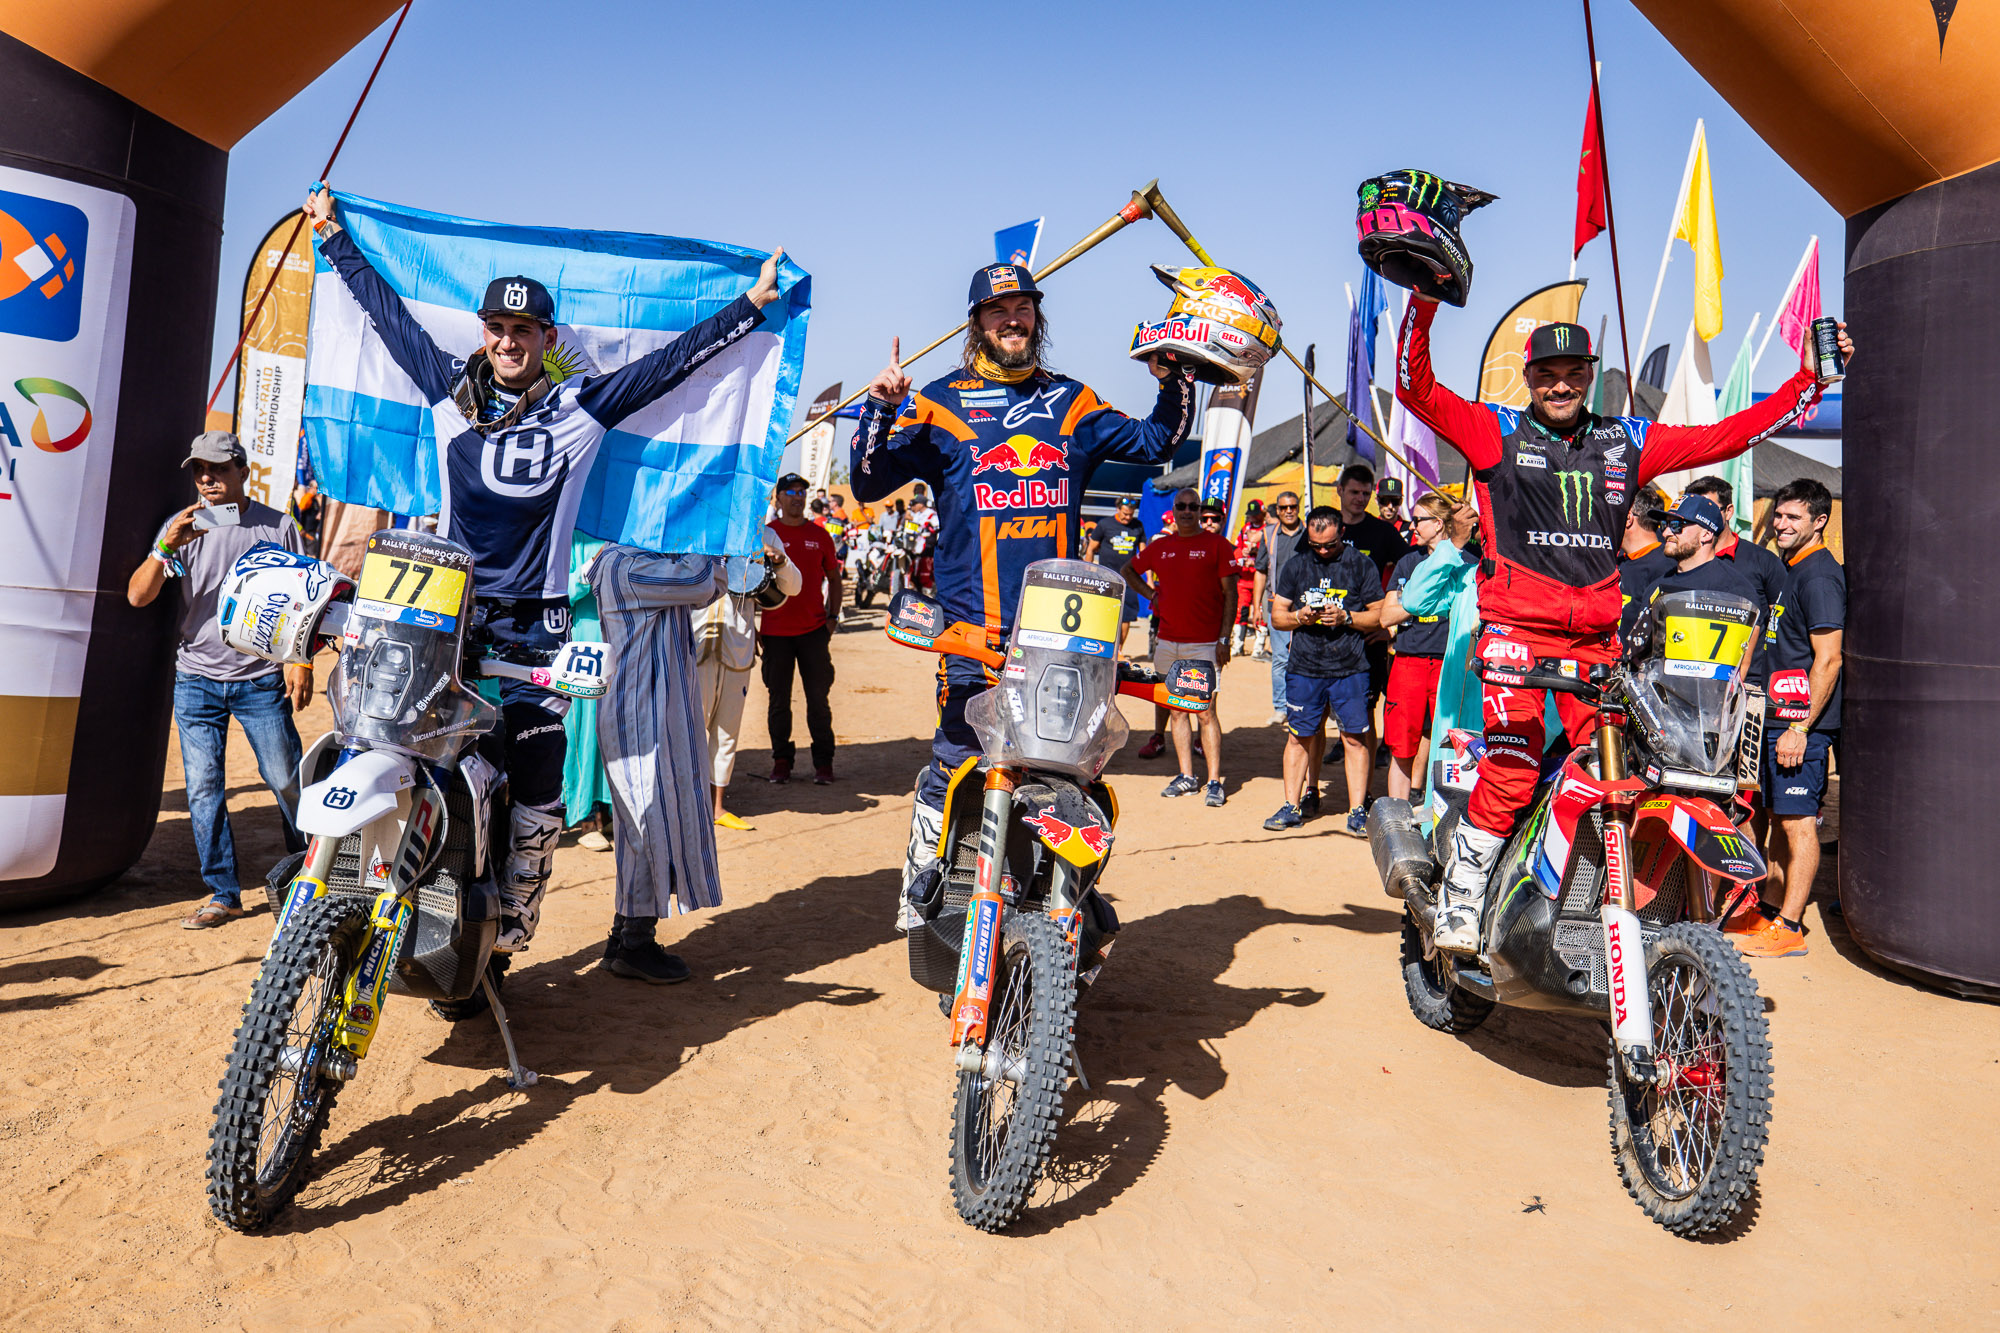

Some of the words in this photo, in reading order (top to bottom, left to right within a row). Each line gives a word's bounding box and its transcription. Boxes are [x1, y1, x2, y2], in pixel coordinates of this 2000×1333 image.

[1183, 300, 1242, 324] OAKLEY
[1139, 322, 1170, 345] Red
[1170, 322, 1210, 343] Bull
[1222, 333, 1244, 346] BELL
[1400, 306, 1417, 390] alpinestars
[948, 380, 984, 390] KTM
[257, 367, 273, 454] RALLY-RAID
[266, 366, 283, 456] CHAMPIONSHIP
[974, 480, 1028, 510] Red
[1029, 478, 1068, 508] Bull
[997, 516, 1056, 539] KTM
[1696, 514, 1710, 526] RACING
[1710, 522, 1718, 531] TEAM
[382, 540, 407, 550] RALLYE
[422, 547, 452, 560] MAROC
[1527, 530, 1612, 550] HONDA
[385, 560, 434, 604] 77
[1042, 572, 1070, 582] RALLYE
[1084, 578, 1110, 588] MAROC
[362, 604, 386, 612] AFRIQUIA
[899, 609, 917, 621] Red
[917, 614, 934, 628] Bull
[1061, 594, 1082, 632] 8
[1686, 602, 1714, 612] RALLYE
[1727, 607, 1748, 617] MAROC
[252, 593, 290, 654] LUCIANO
[415, 616, 434, 624] Telecom
[896, 631, 932, 646] MOTOREX
[1483, 638, 1528, 661] GIVI
[1709, 622, 1728, 660] 7
[1176, 678, 1194, 688] Red
[1194, 680, 1208, 692] Bull
[1486, 672, 1521, 684] MOTUL
[569, 684, 606, 696] MOTOREX
[1006, 688, 1024, 722] KTM
[1086, 702, 1108, 739] KTM
[1488, 735, 1528, 745] HONDA
[1740, 711, 1760, 781] 100%
[1447, 764, 1460, 783] HRC
[1785, 787, 1808, 796] KTM
[1605, 830, 1623, 899] SHOWA
[1721, 859, 1754, 868] HONDA
[386, 911, 412, 979] MOTOREX
[976, 906, 992, 976] MICHELIN
[956, 922, 974, 991] MOTOREX
[1608, 921, 1627, 1029] HONDA
